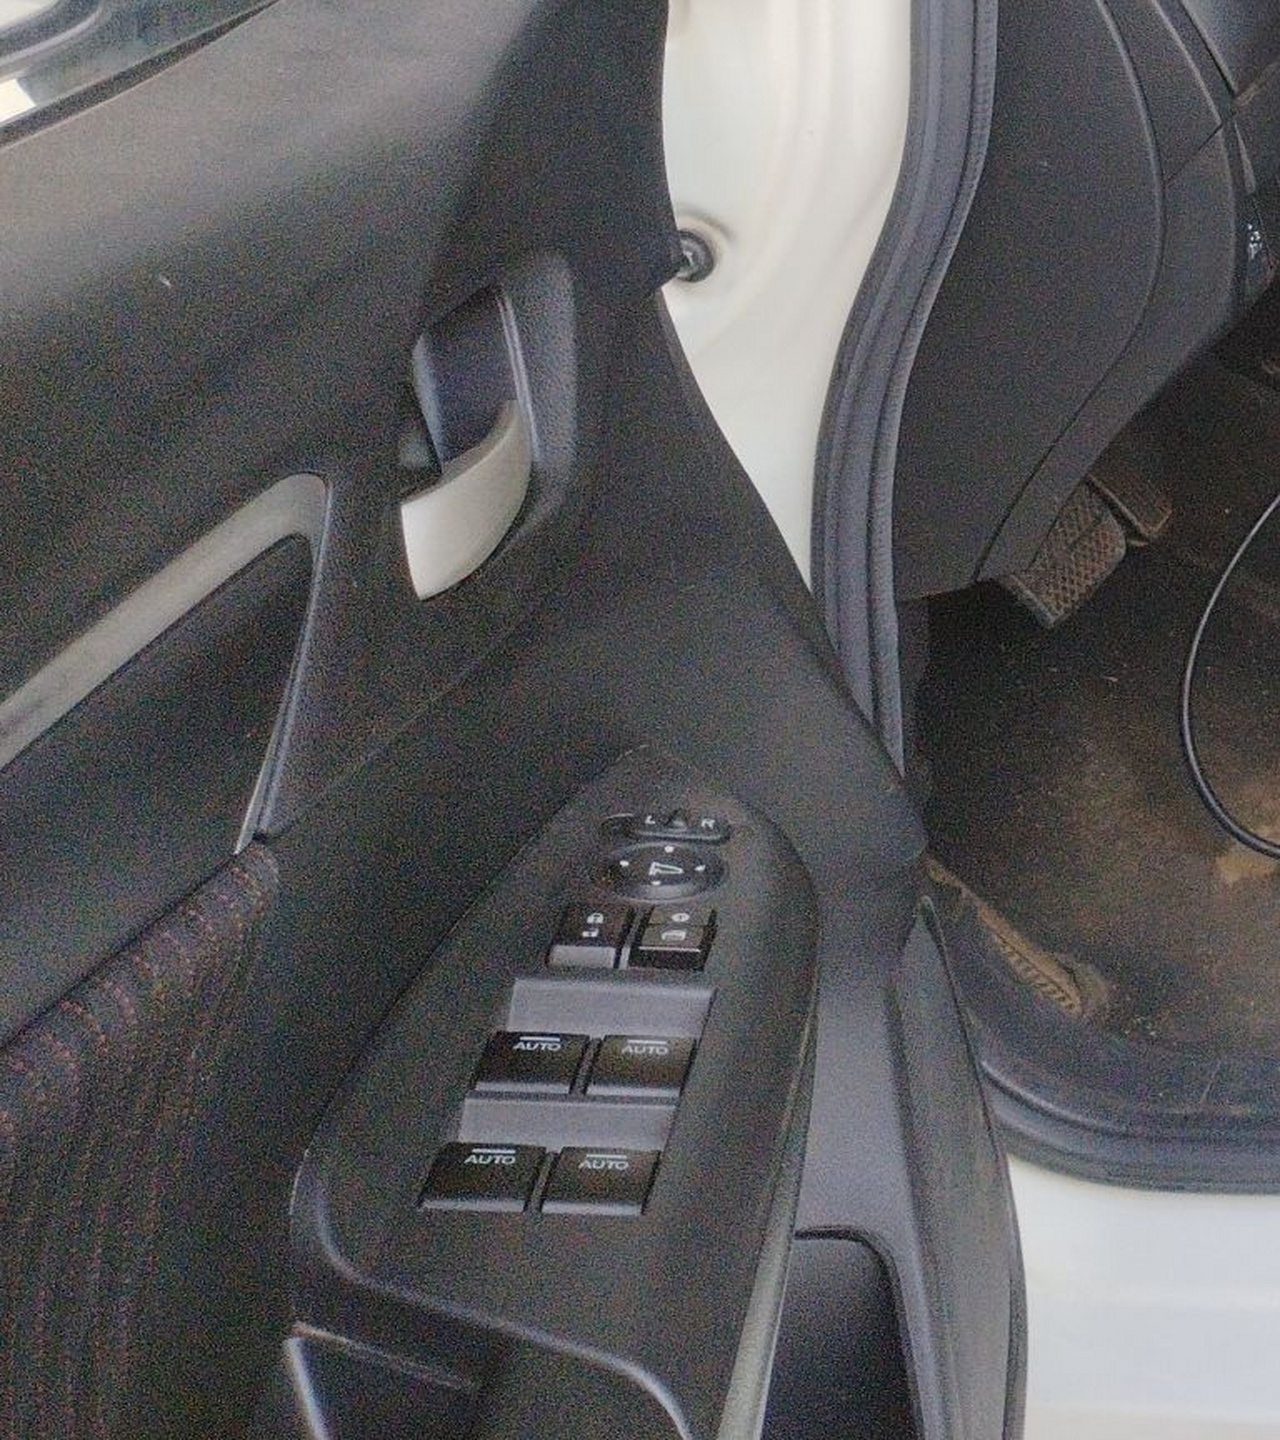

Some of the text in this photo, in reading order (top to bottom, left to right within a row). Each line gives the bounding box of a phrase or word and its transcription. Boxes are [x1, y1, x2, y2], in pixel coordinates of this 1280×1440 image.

[514, 1041, 669, 1055] AUTO AUTO
[464, 1154, 629, 1171] AUTO AUTO
